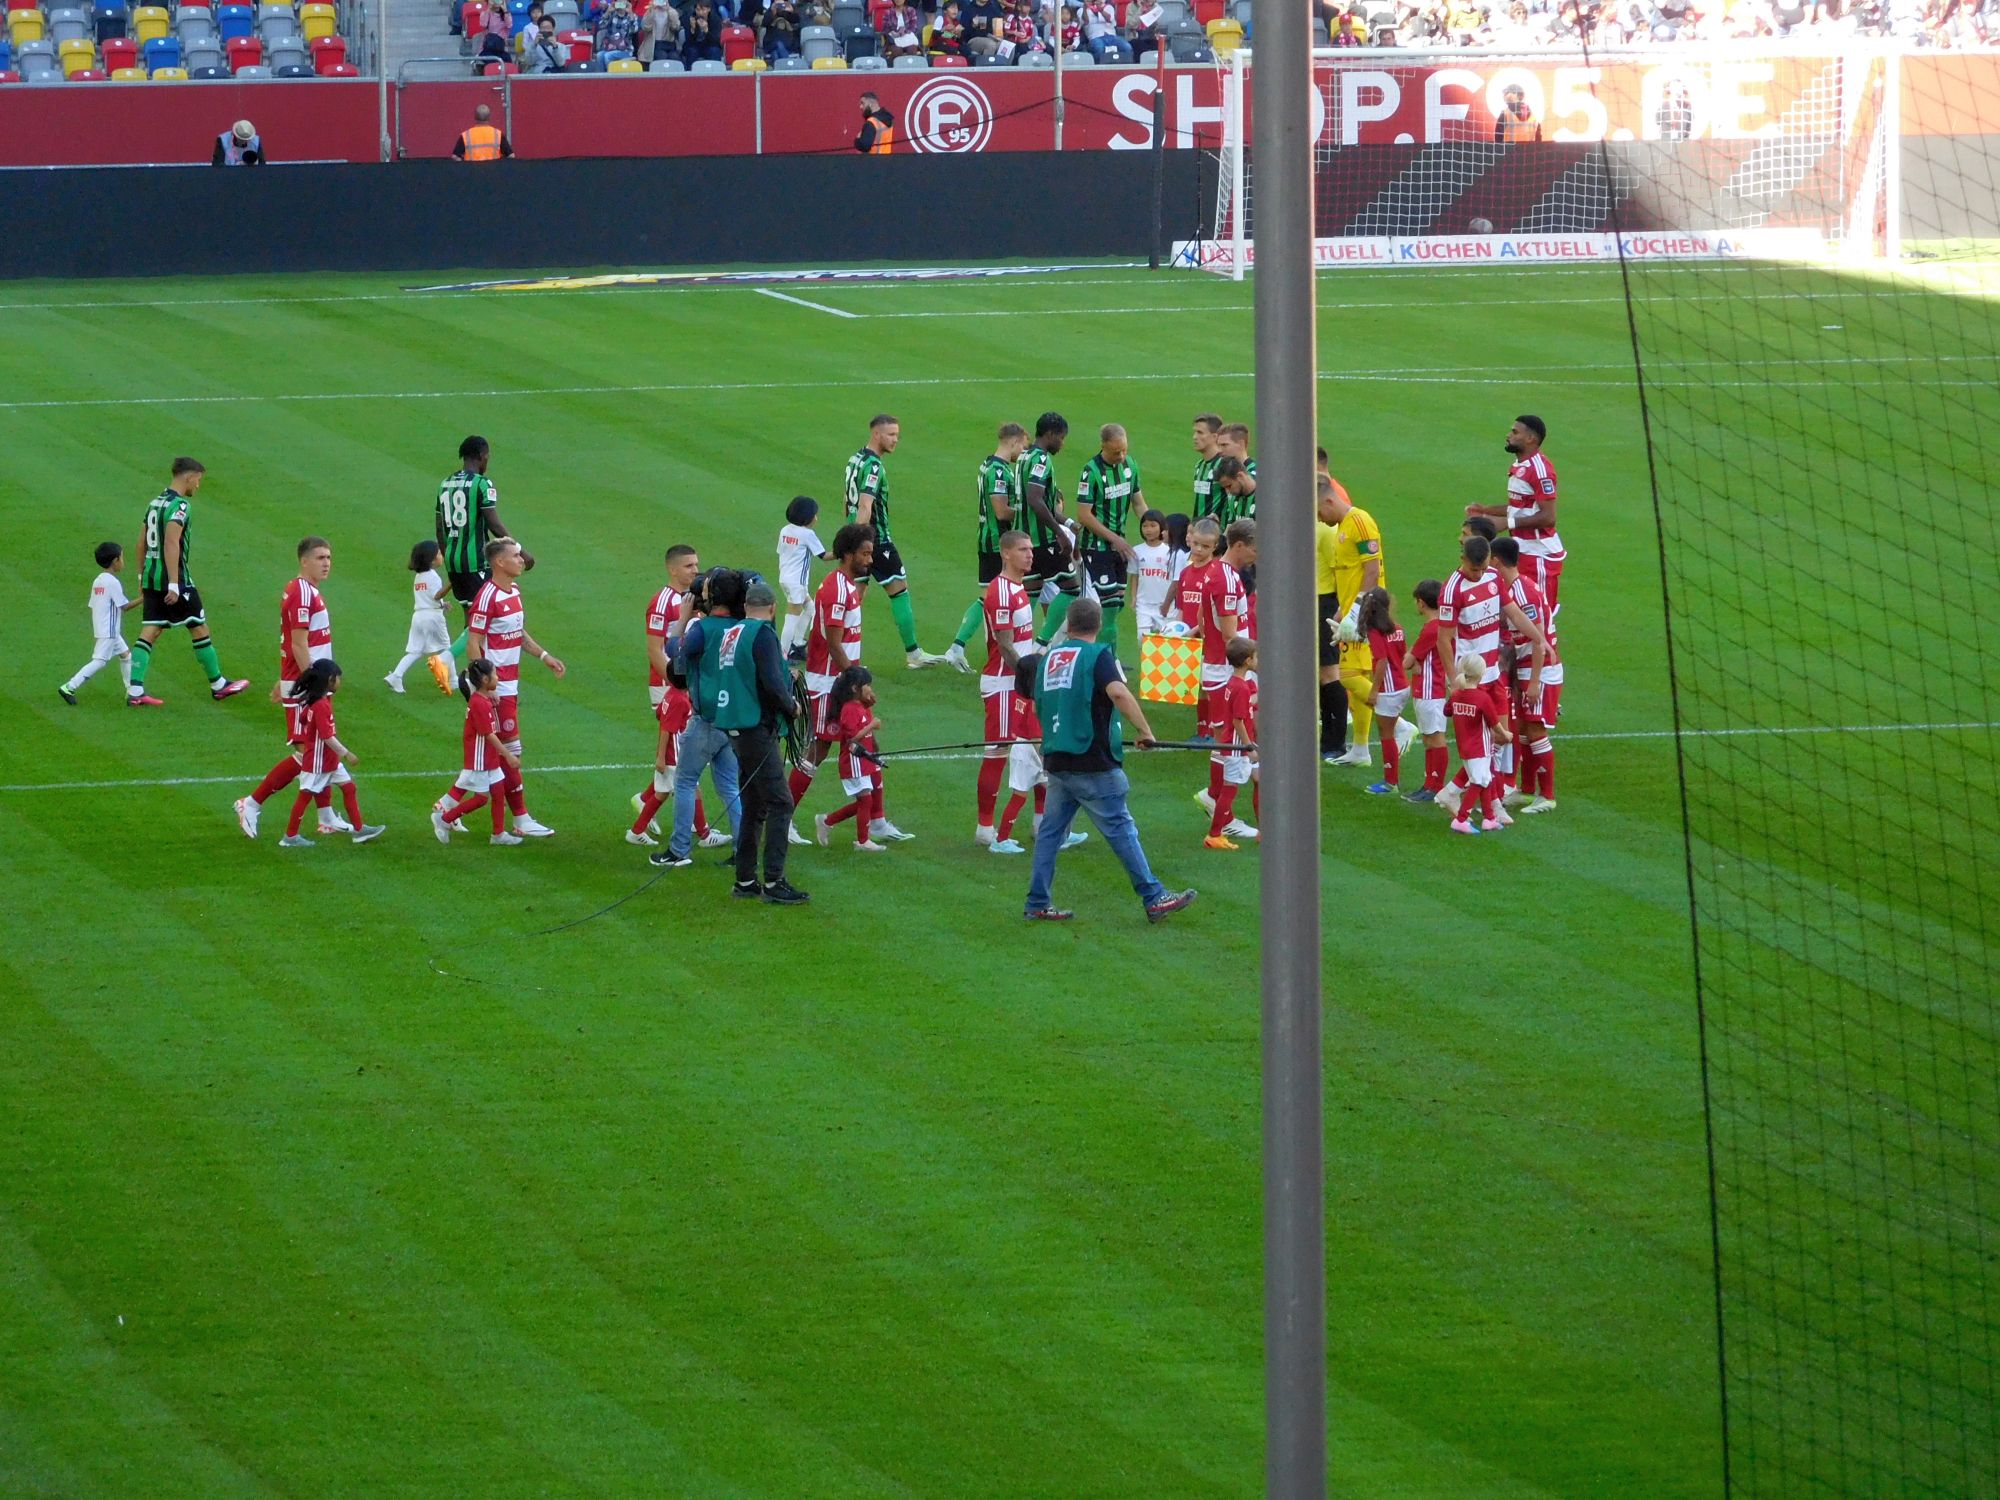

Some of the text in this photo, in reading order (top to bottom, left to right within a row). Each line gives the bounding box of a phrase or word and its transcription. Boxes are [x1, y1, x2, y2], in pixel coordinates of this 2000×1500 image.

[1401, 239, 1598, 260] KÜCHEN AKTUELL
[1619, 236, 1709, 256] KÜCHEN
[440, 489, 467, 528] 18
[146, 509, 160, 548] 8
[717, 689, 730, 708] 9
